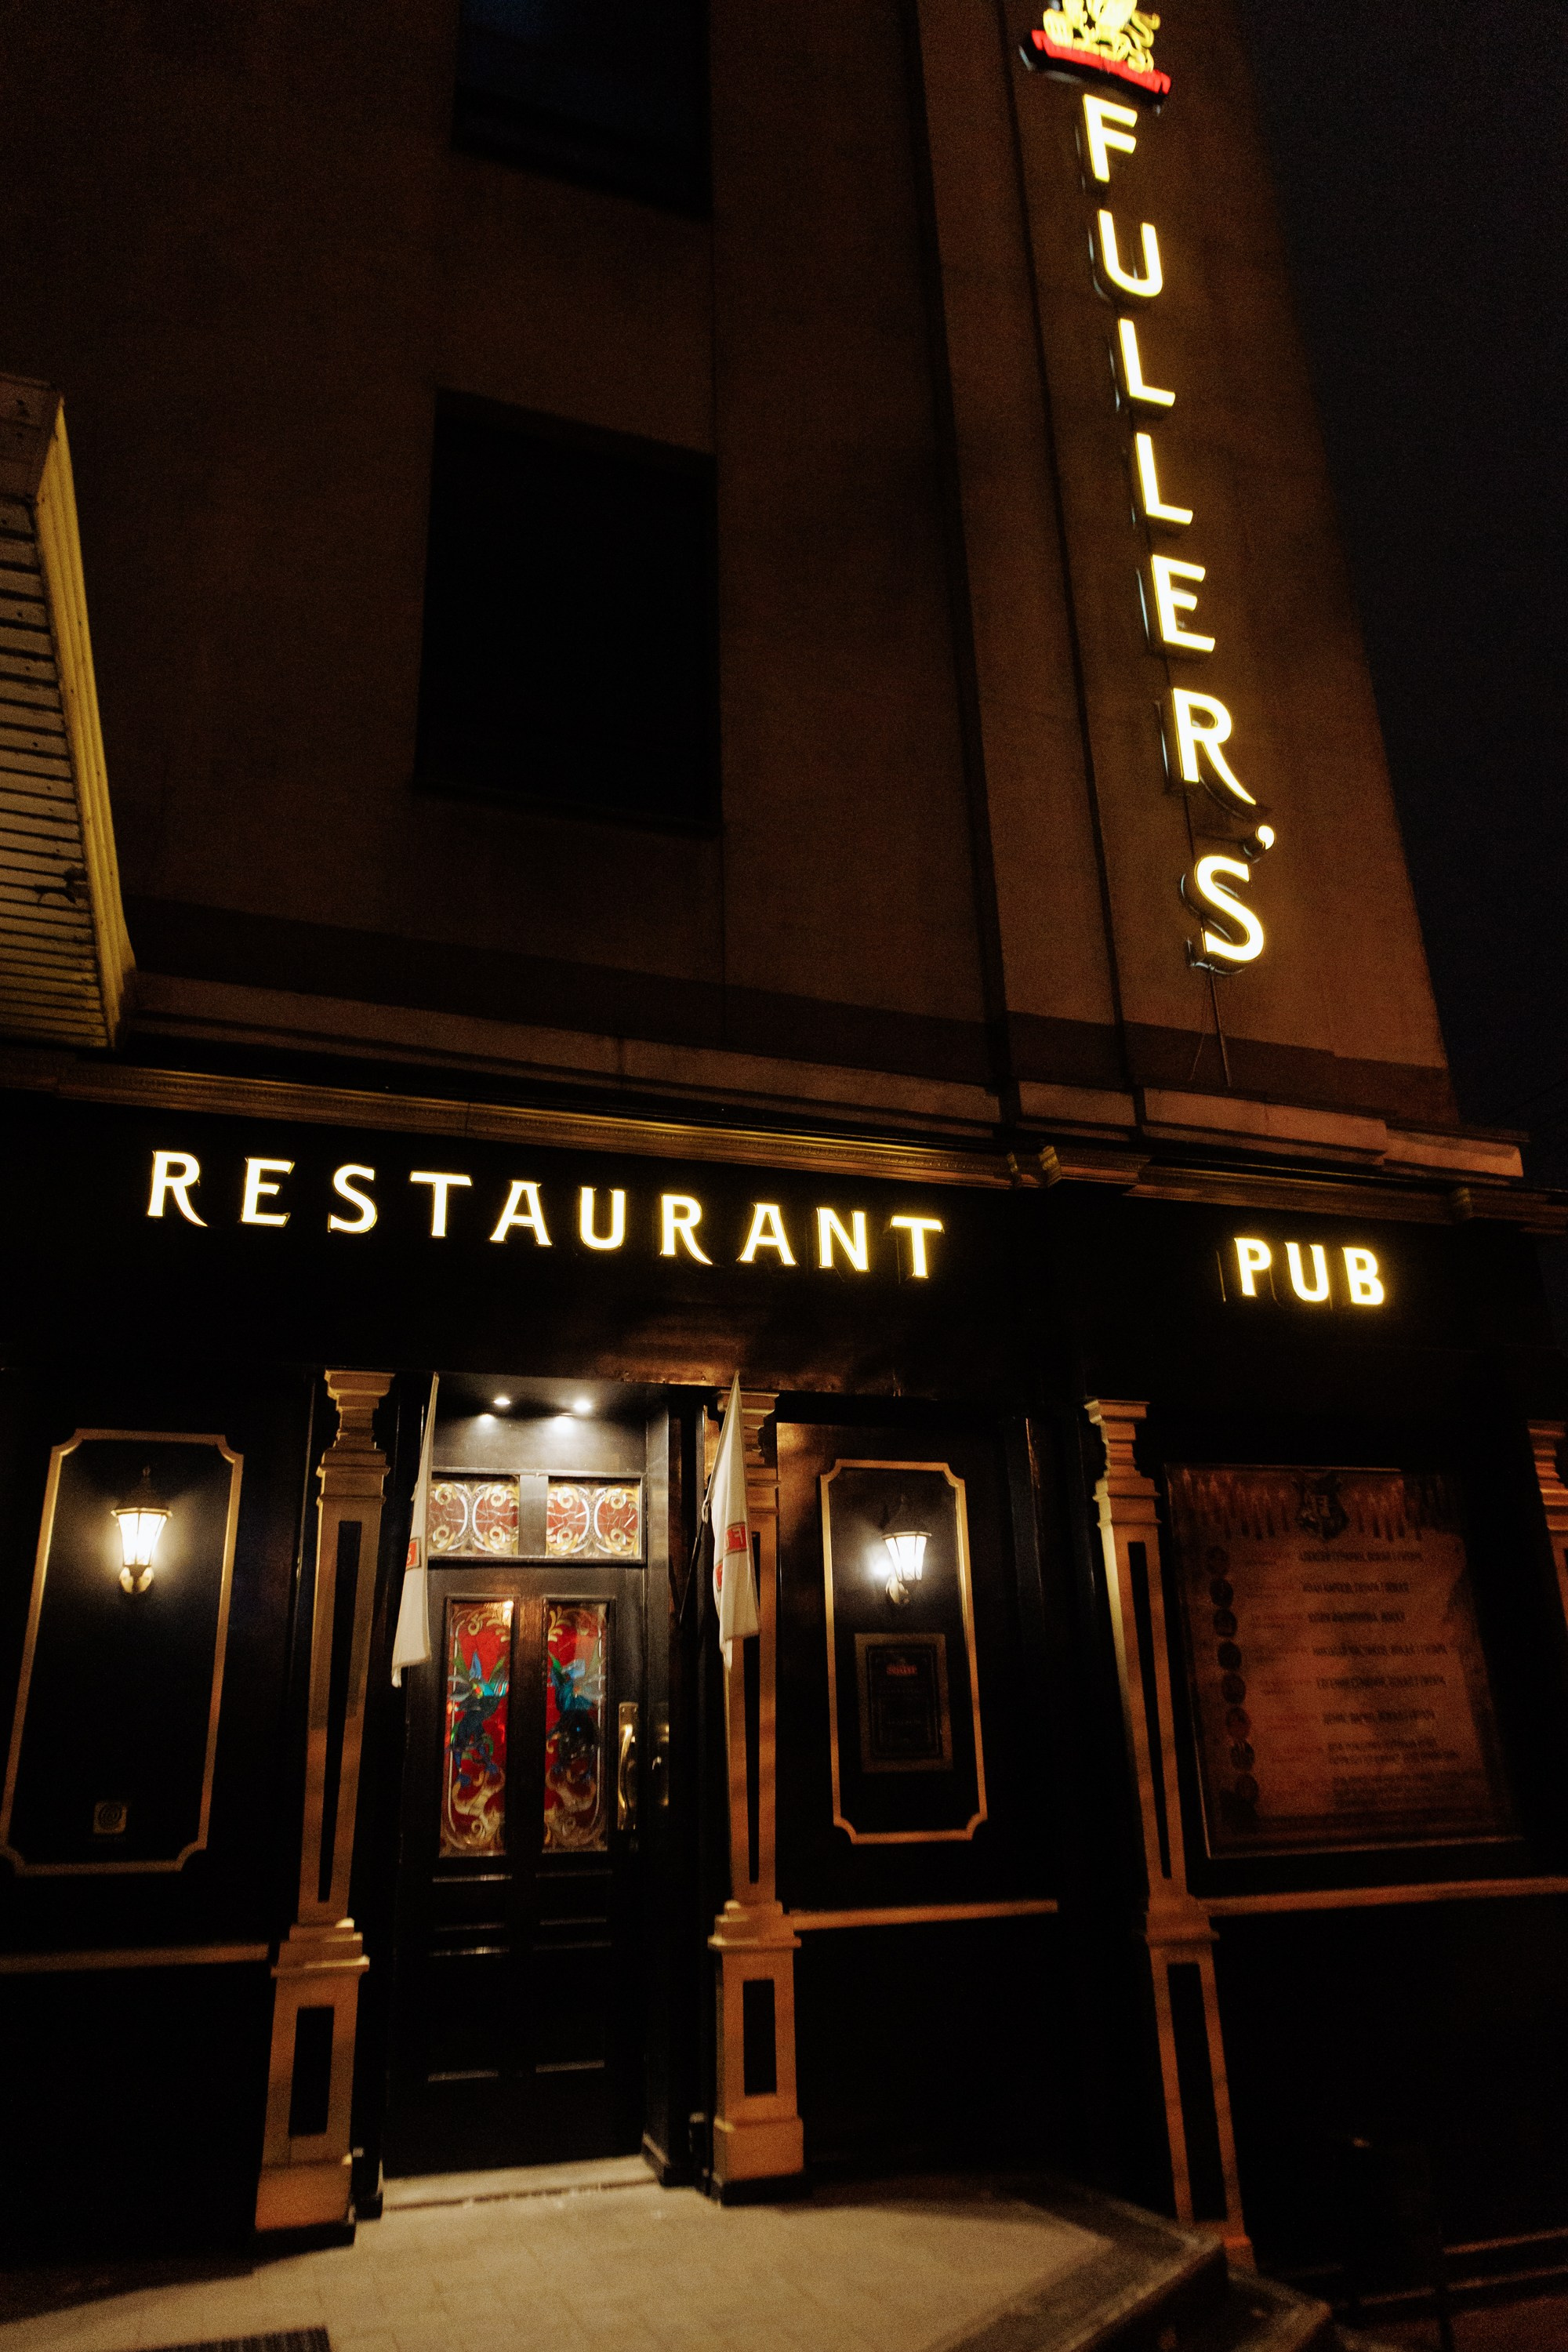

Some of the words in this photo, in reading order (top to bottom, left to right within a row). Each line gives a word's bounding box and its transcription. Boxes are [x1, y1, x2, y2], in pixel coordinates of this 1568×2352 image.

[1083, 93, 1276, 963] FULLER'S
[147, 1150, 946, 1279] RESTAURANT
[1233, 1236, 1386, 1306] PUB
